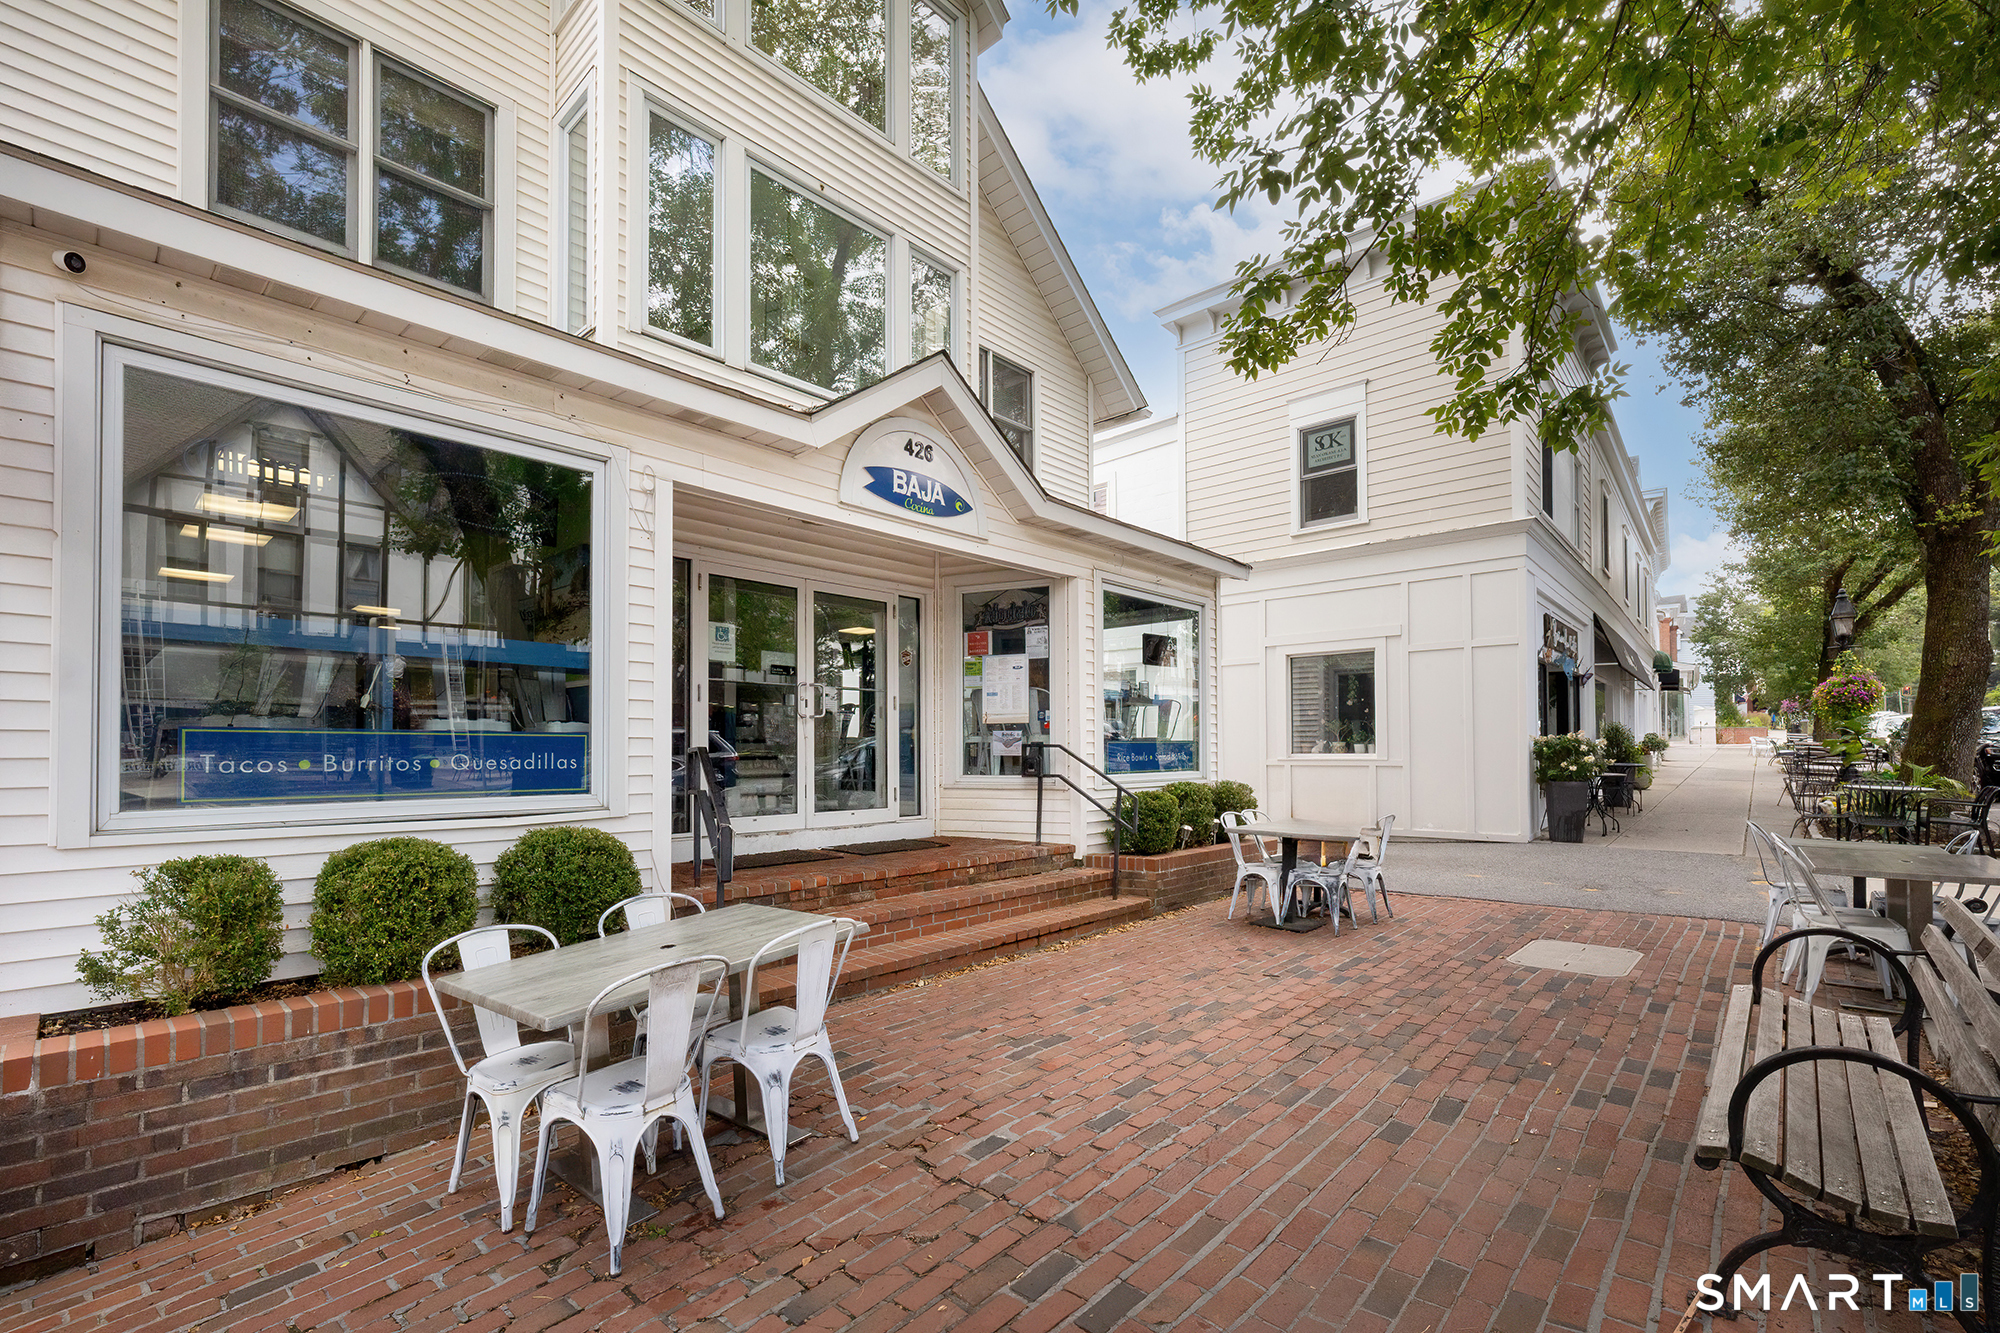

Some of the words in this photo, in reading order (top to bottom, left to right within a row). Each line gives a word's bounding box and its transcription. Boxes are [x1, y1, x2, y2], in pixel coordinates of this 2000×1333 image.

[903, 438, 934, 463] 426
[1315, 430, 1344, 452] SOK
[892, 468, 946, 507] BAJA
[904, 497, 935, 516] Cocina
[199, 754, 288, 774] Tacos
[323, 754, 422, 772] Burritos
[451, 752, 578, 771] Quesadillas
[1116, 752, 1130, 762] Rice
[1131, 751, 1148, 762] Bowls
